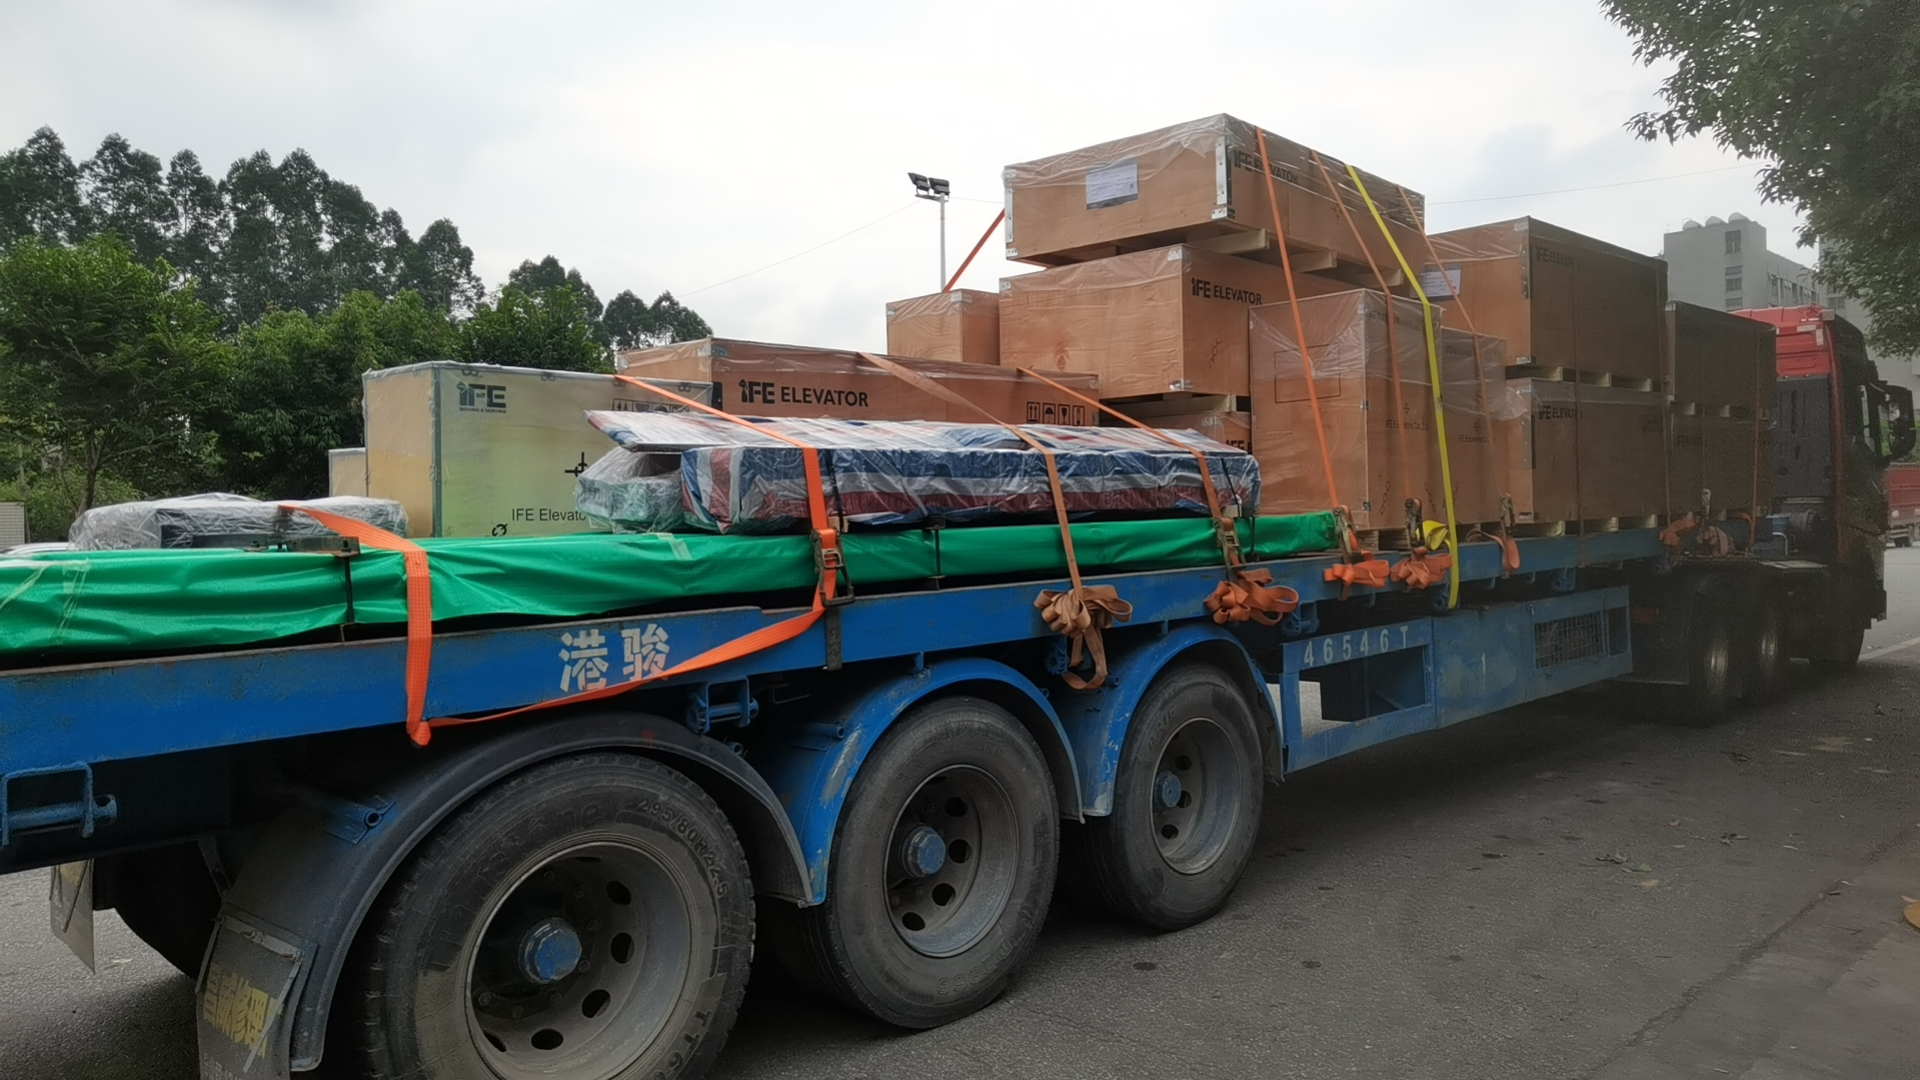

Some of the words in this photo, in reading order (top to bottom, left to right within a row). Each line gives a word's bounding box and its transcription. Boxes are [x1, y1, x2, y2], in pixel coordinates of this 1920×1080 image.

[1254, 158, 1299, 185] EVATOR
[1191, 277, 1211, 298] IFE
[1213, 285, 1262, 305] ELEVATOR
[738, 379, 775, 404] IFE
[781, 386, 869, 408] ELEVATOR
[512, 508, 535, 521] IFE
[558, 623, 671, 693] 港骏
